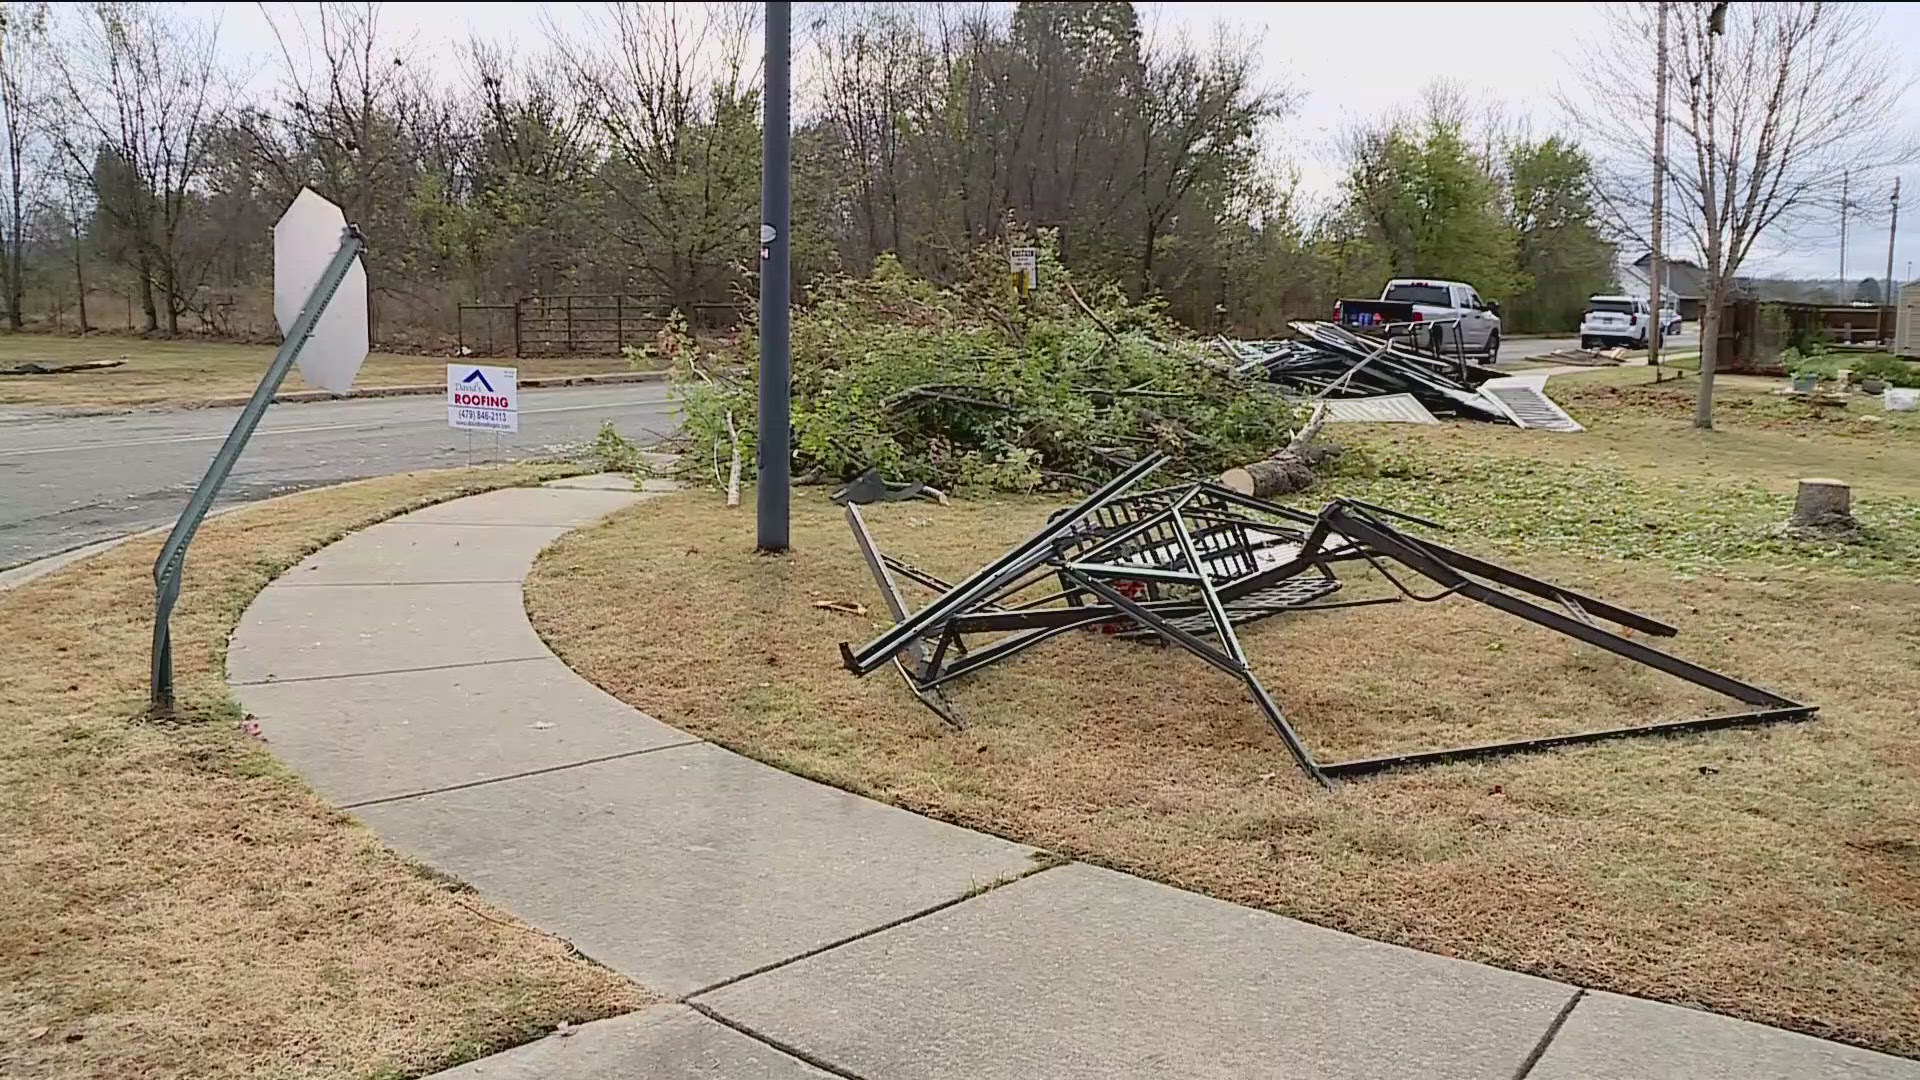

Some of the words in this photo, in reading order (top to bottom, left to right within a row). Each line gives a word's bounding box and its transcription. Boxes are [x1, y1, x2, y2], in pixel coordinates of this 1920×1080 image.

[455, 382, 482, 392] David's
[454, 394, 509, 408] ROOFING
[458, 409, 476, 420] (479)
[477, 410, 507, 422] 846-2113
